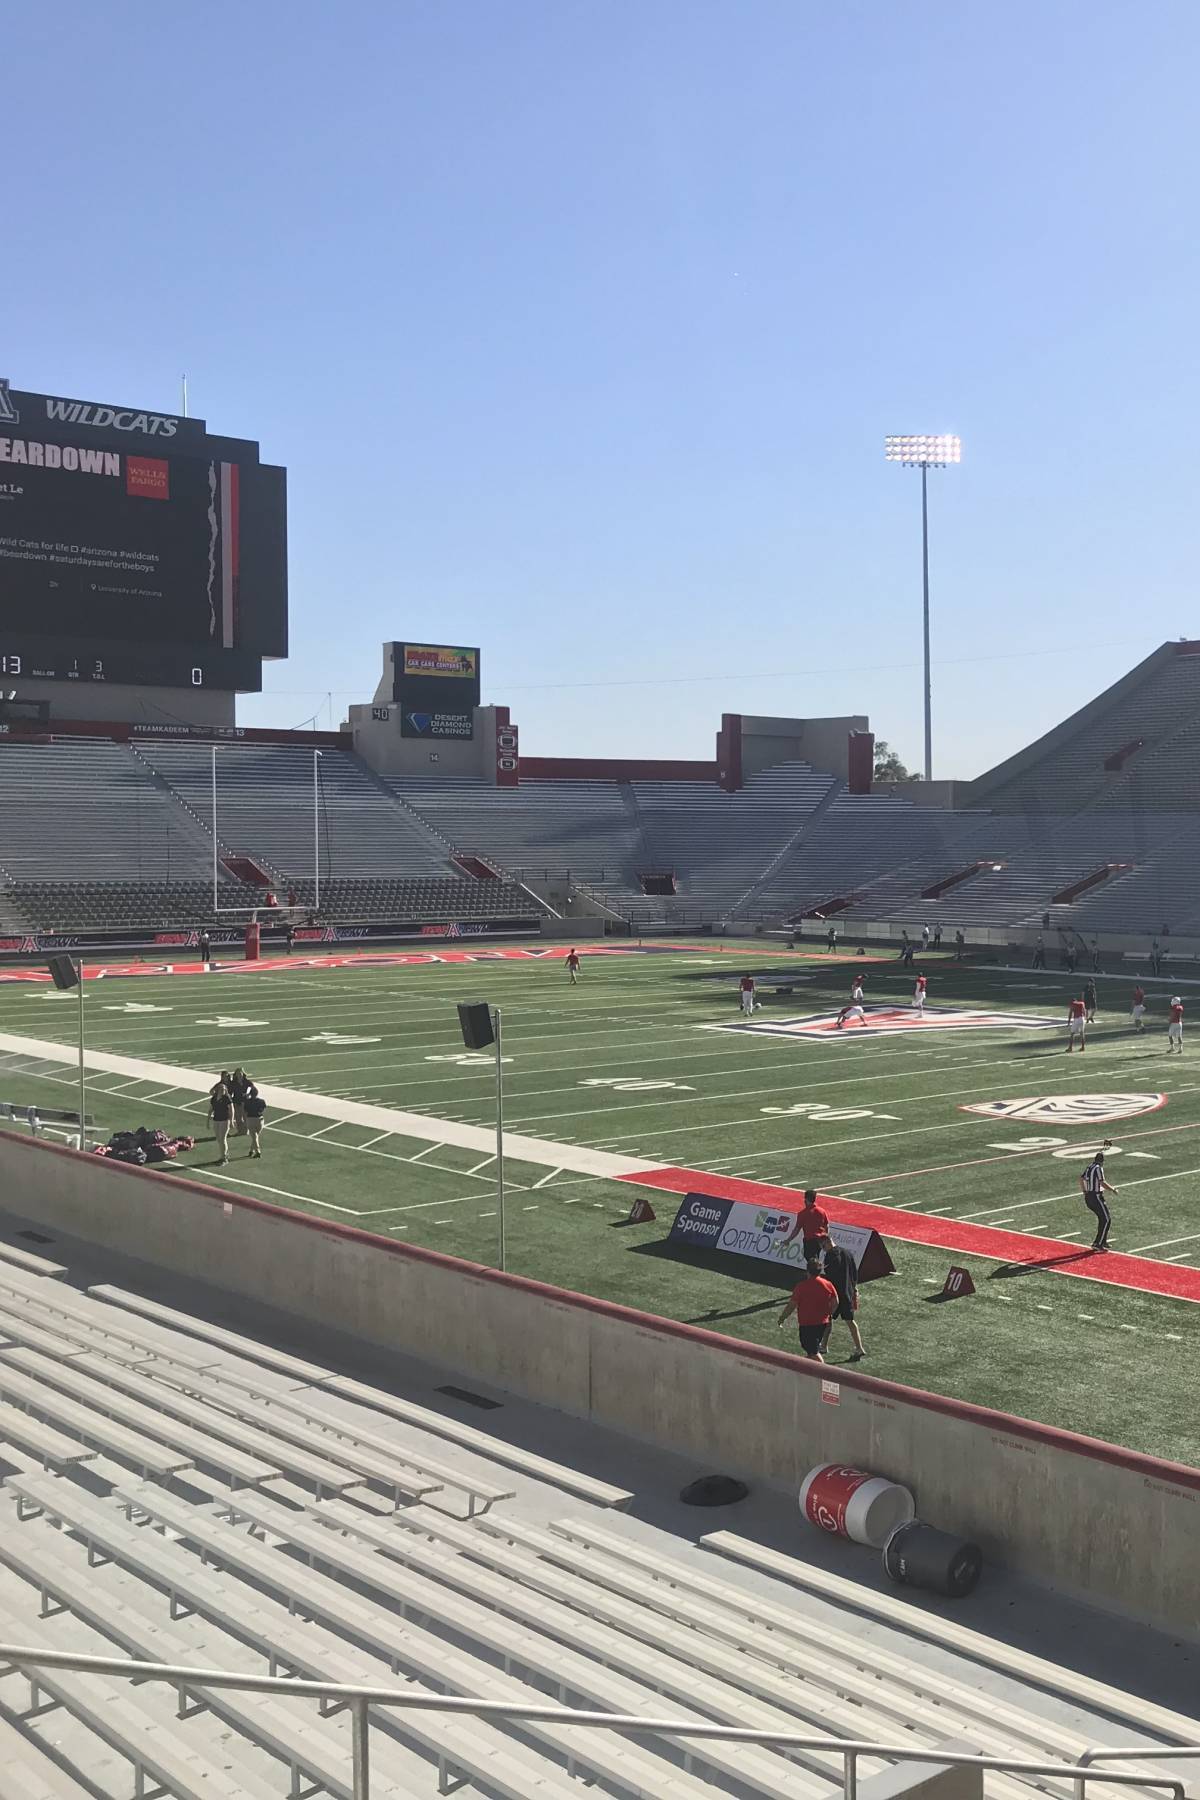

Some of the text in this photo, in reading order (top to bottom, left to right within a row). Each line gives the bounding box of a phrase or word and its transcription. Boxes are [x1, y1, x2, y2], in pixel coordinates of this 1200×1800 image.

[46, 399, 179, 437] WILDCATS
[129, 467, 166, 479] WELLS
[130, 477, 165, 488] FARGO
[19, 539, 39, 549] Cats
[120, 551, 159, 562] #wildcats
[95, 660, 103, 672] 3
[191, 667, 202, 685] 0
[374, 708, 388, 720] 40
[435, 714, 468, 722] DESERT
[431, 720, 472, 729] DIAMOND
[431, 727, 471, 735] CASINOS
[758, 1103, 874, 1121] 30
[987, 1136, 1123, 1159] 20
[690, 1201, 722, 1221] Game
[677, 1214, 720, 1236] Sponsor
[947, 1271, 964, 1292] 10
